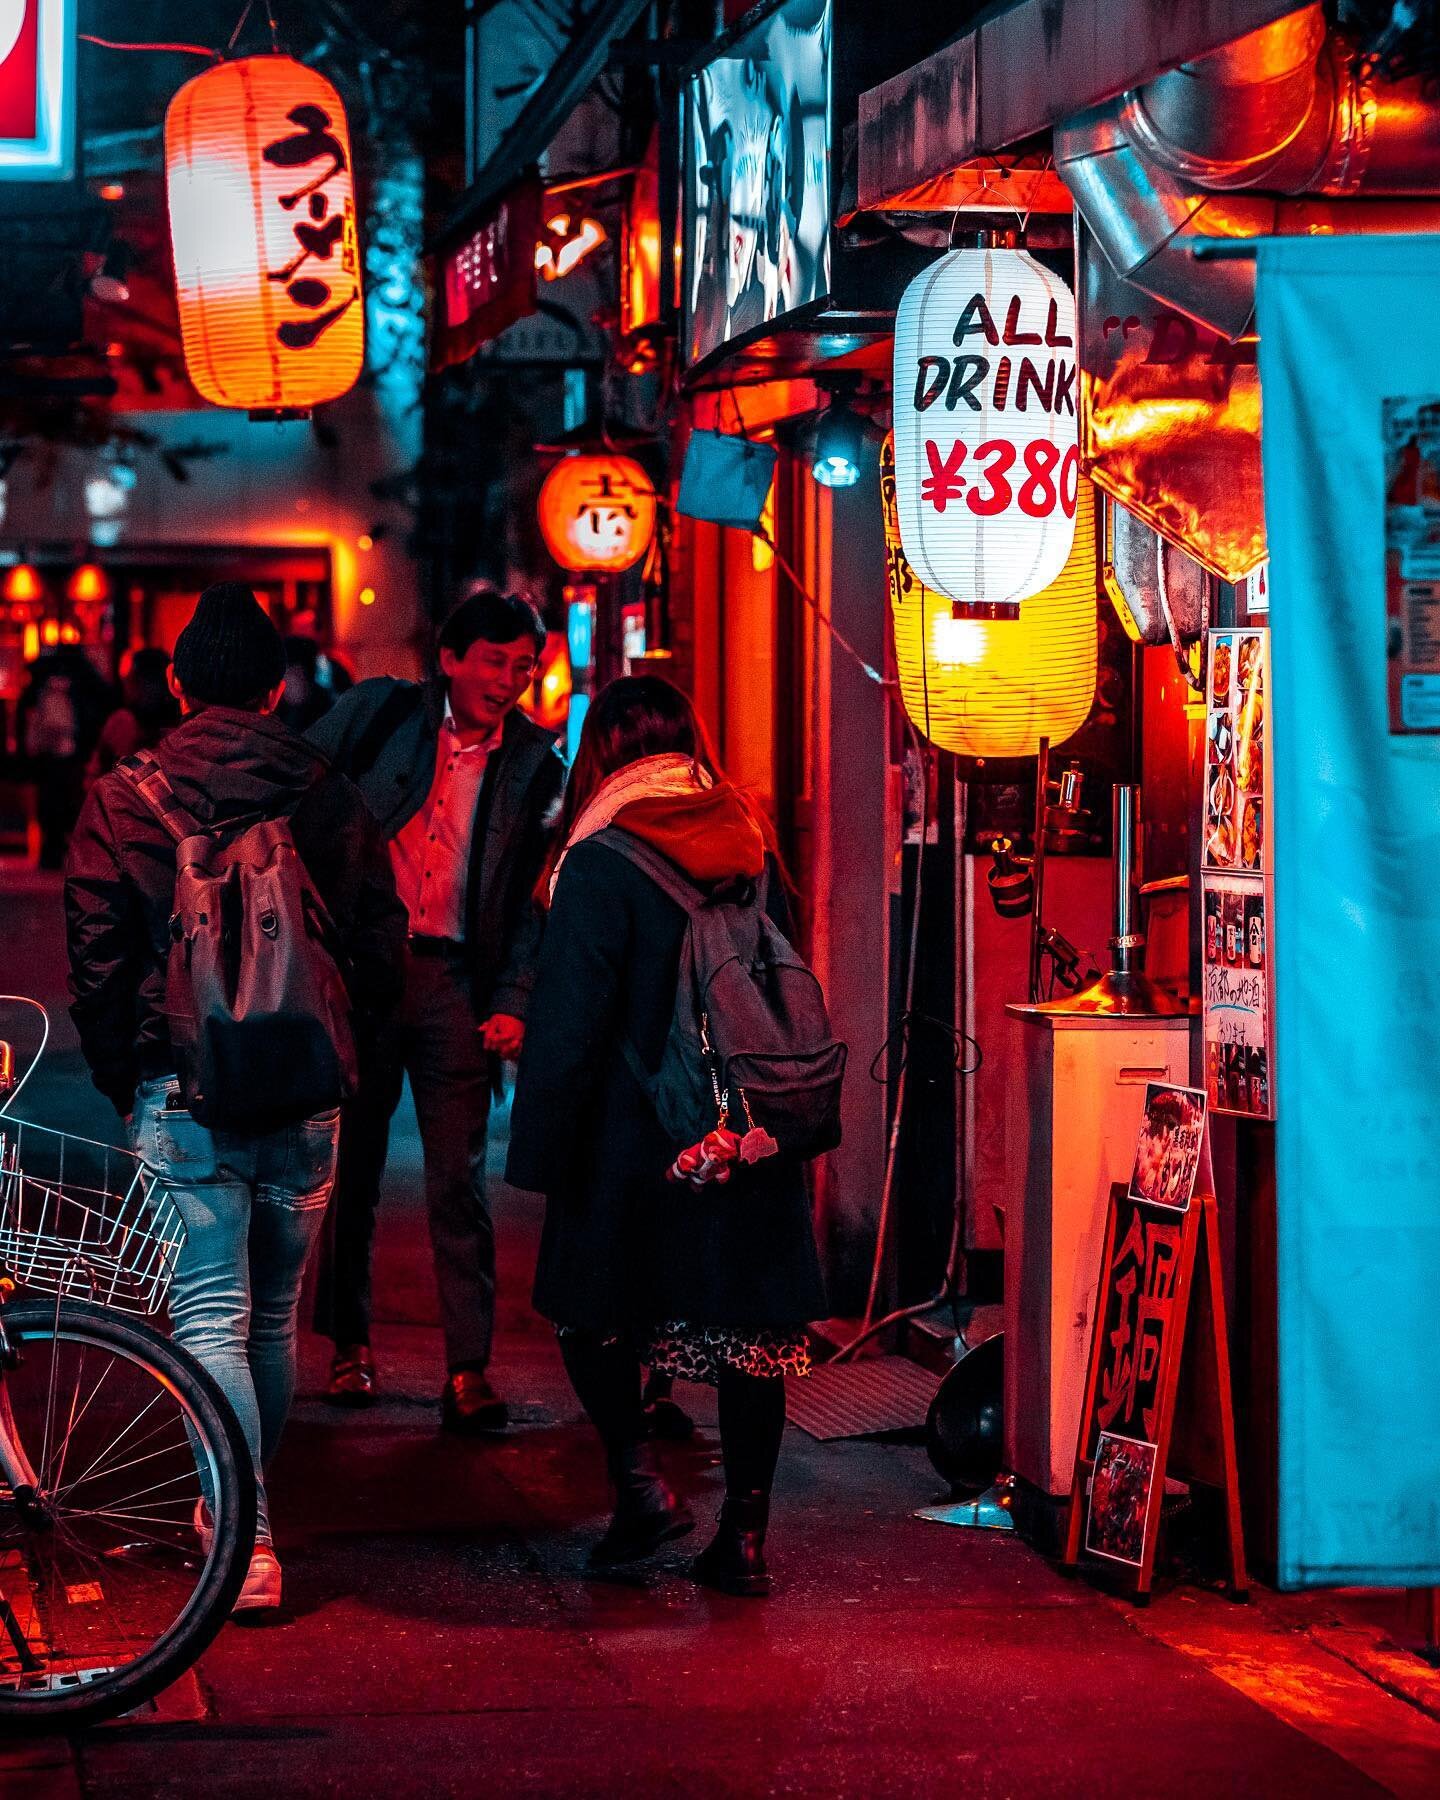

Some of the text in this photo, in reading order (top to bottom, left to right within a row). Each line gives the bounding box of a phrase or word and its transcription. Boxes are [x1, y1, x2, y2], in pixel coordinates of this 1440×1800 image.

[263, 104, 360, 350] ラーメン
[952, 293, 1073, 347] ALL
[914, 354, 1077, 417] DRINK
[921, 438, 1079, 519] ¥380
